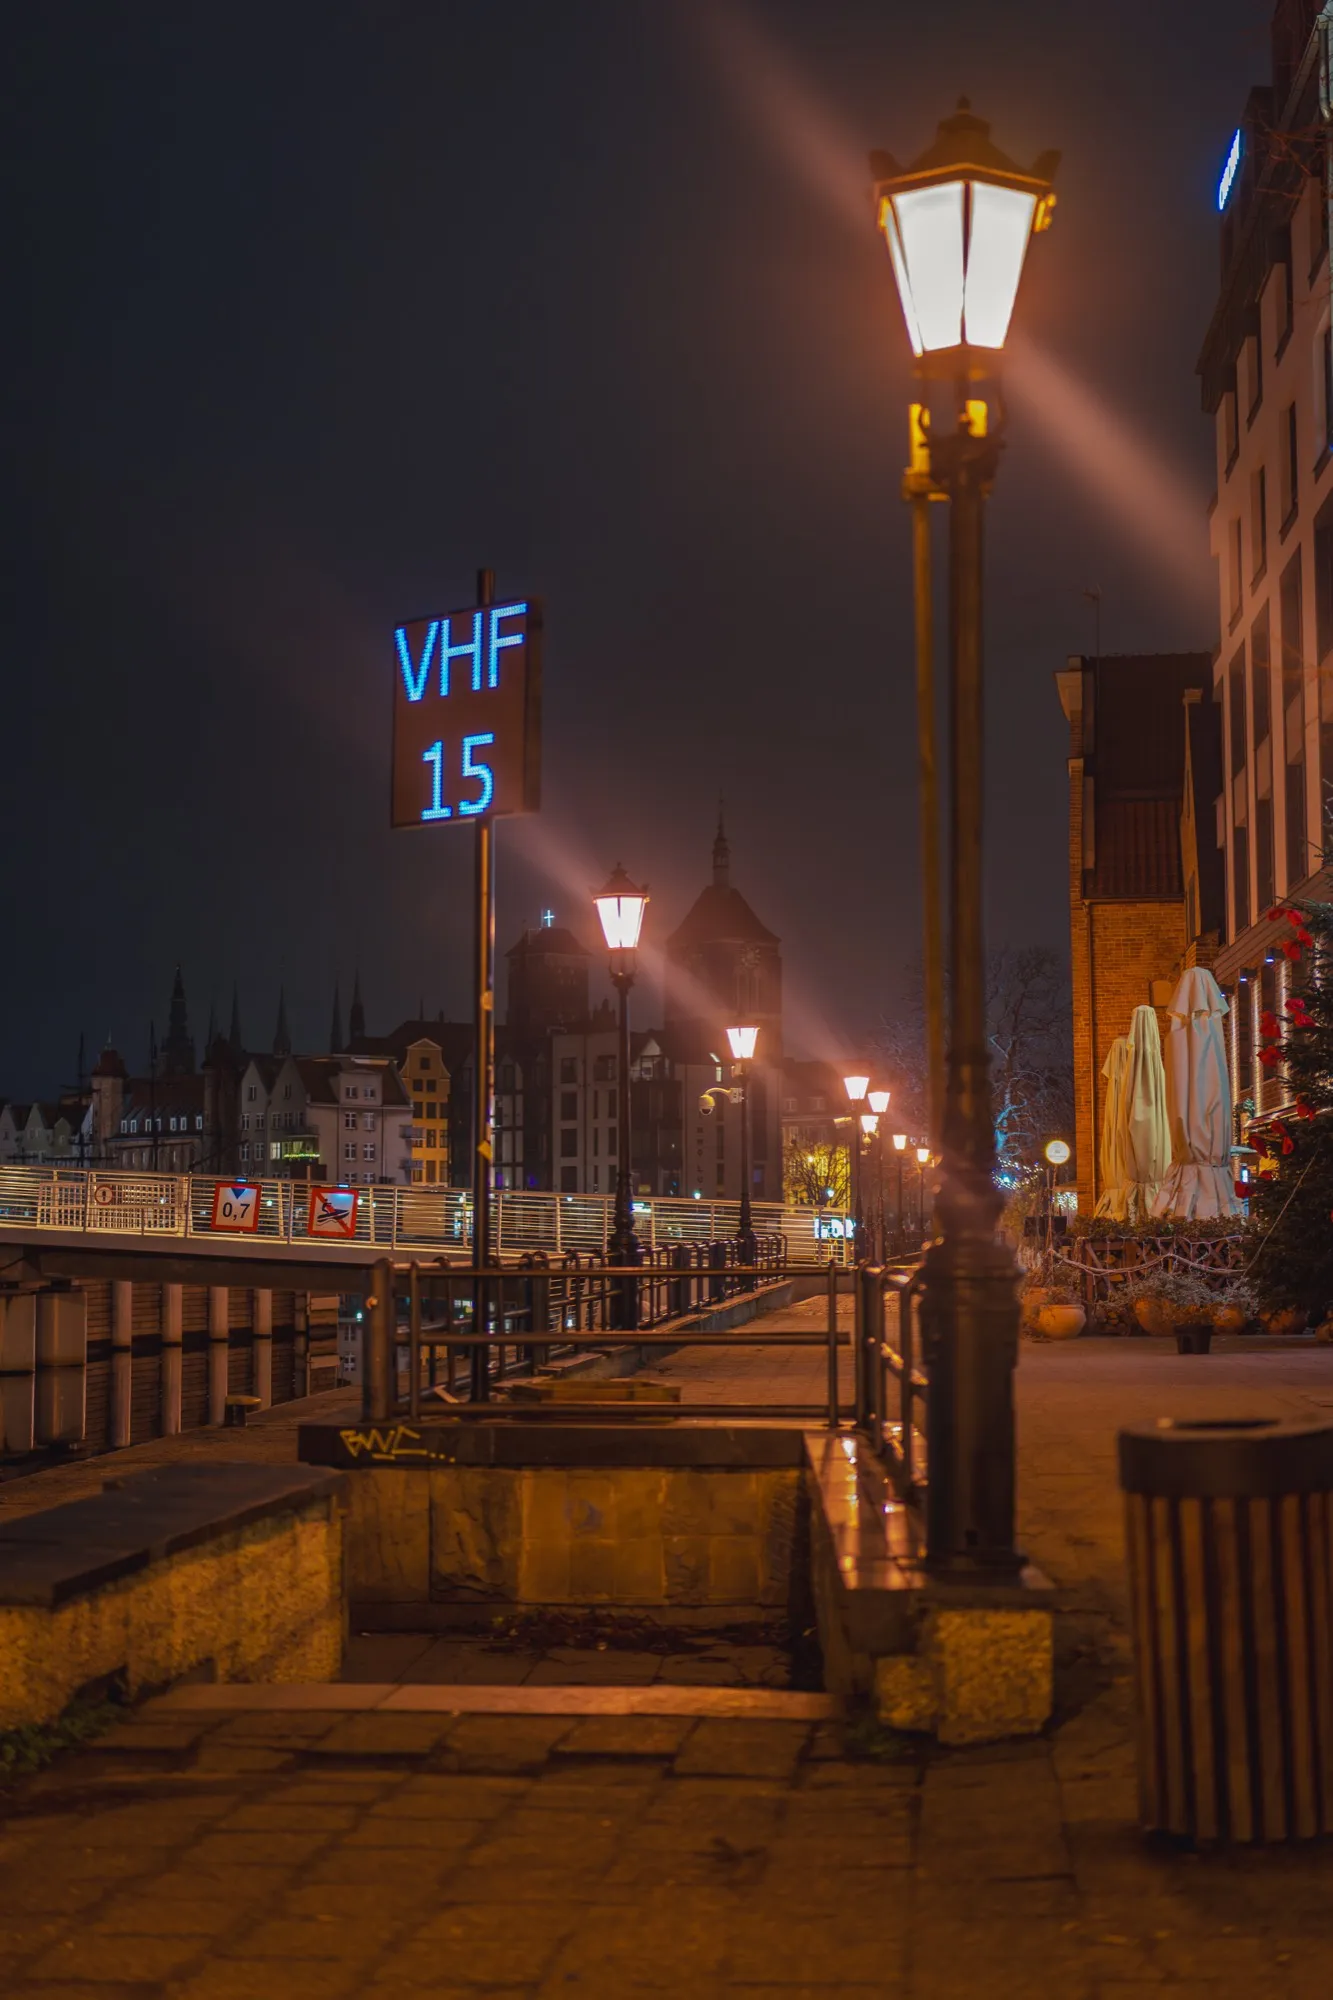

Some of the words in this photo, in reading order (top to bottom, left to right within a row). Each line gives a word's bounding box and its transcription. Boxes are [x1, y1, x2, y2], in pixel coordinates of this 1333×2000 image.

[395, 602, 528, 702] VHF
[420, 732, 495, 821] 15
[222, 1201, 251, 1221] 0,7
